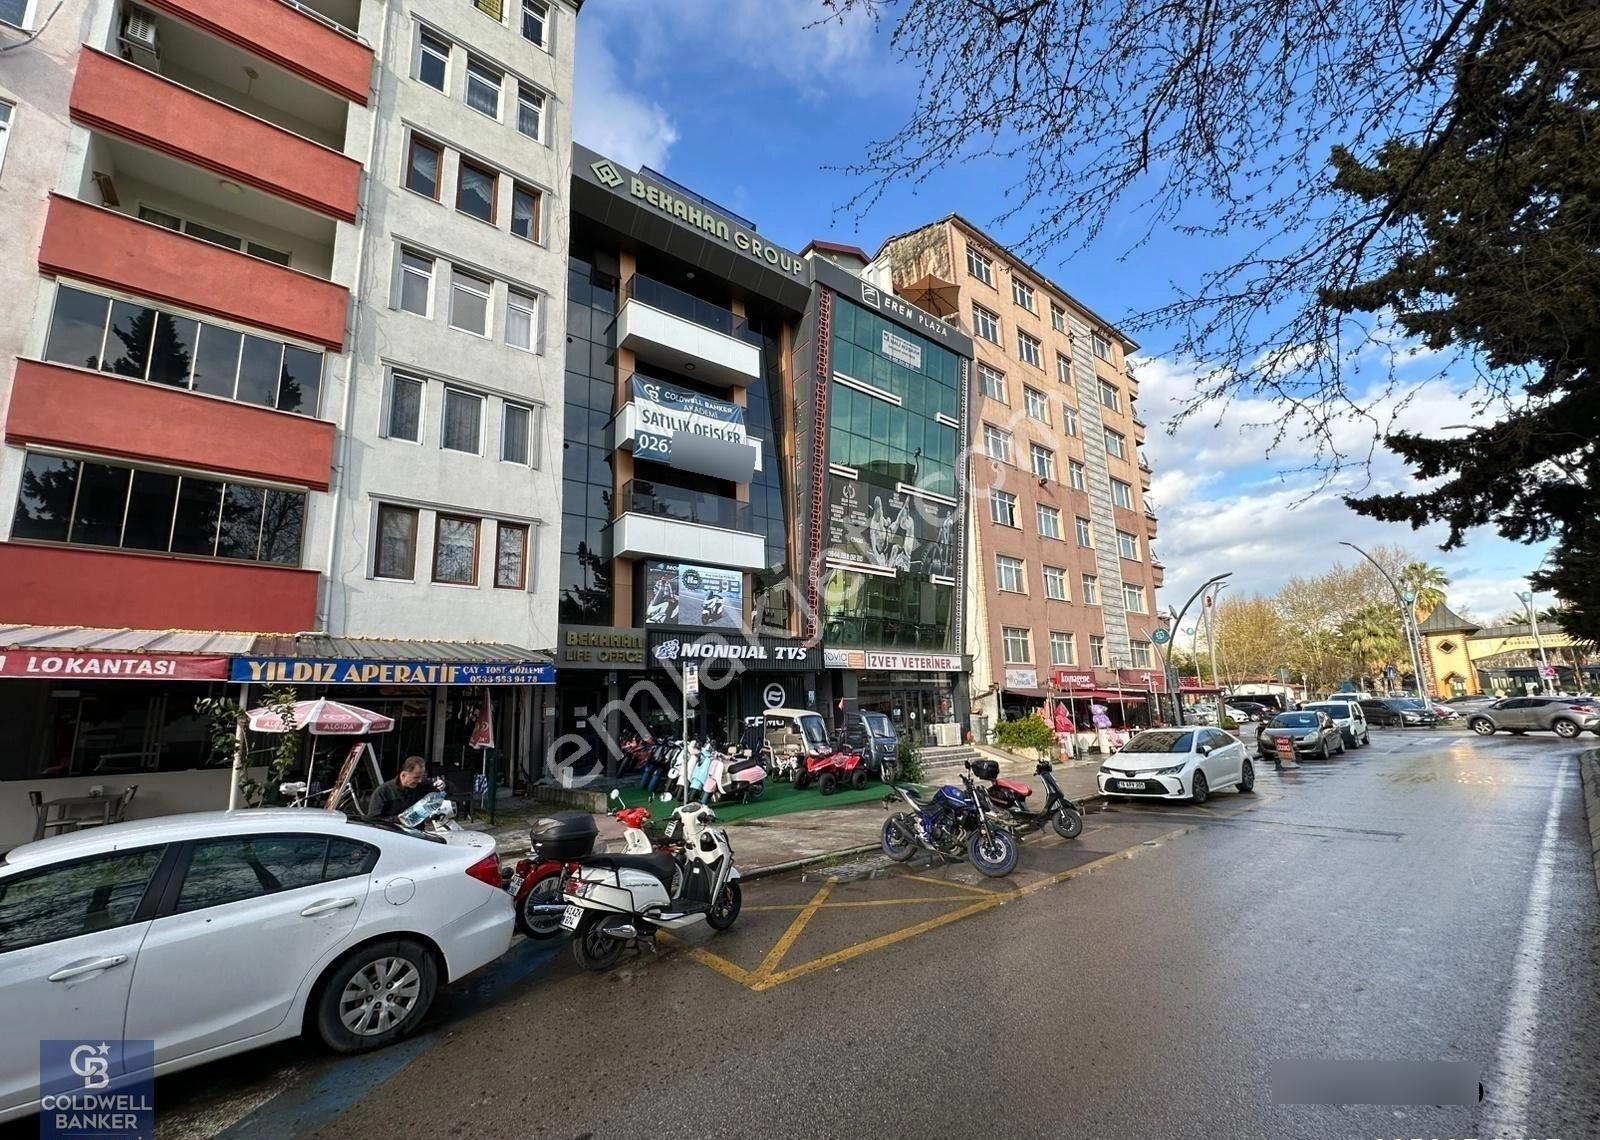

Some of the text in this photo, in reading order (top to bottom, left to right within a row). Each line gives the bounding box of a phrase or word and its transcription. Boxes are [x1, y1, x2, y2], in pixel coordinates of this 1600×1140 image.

[630, 176, 803, 276] BEKAHAN GROUP
[884, 297, 948, 337] EREN PLAZA
[664, 391, 733, 414] COLDWELL BANKER
[642, 409, 691, 434] SATILIK
[566, 631, 642, 648] BEKAHAN
[565, 651, 644, 664] LIFE OFFICE
[680, 643, 807, 660] MONDIAL TVS
[868, 653, 898, 668] İZVET
[902, 655, 951, 669] VETERİNER
[27, 656, 177, 675] LOKANTASI
[248, 661, 462, 683] YILDIZ APERATİF
[463, 665, 480, 675] ÇAY
